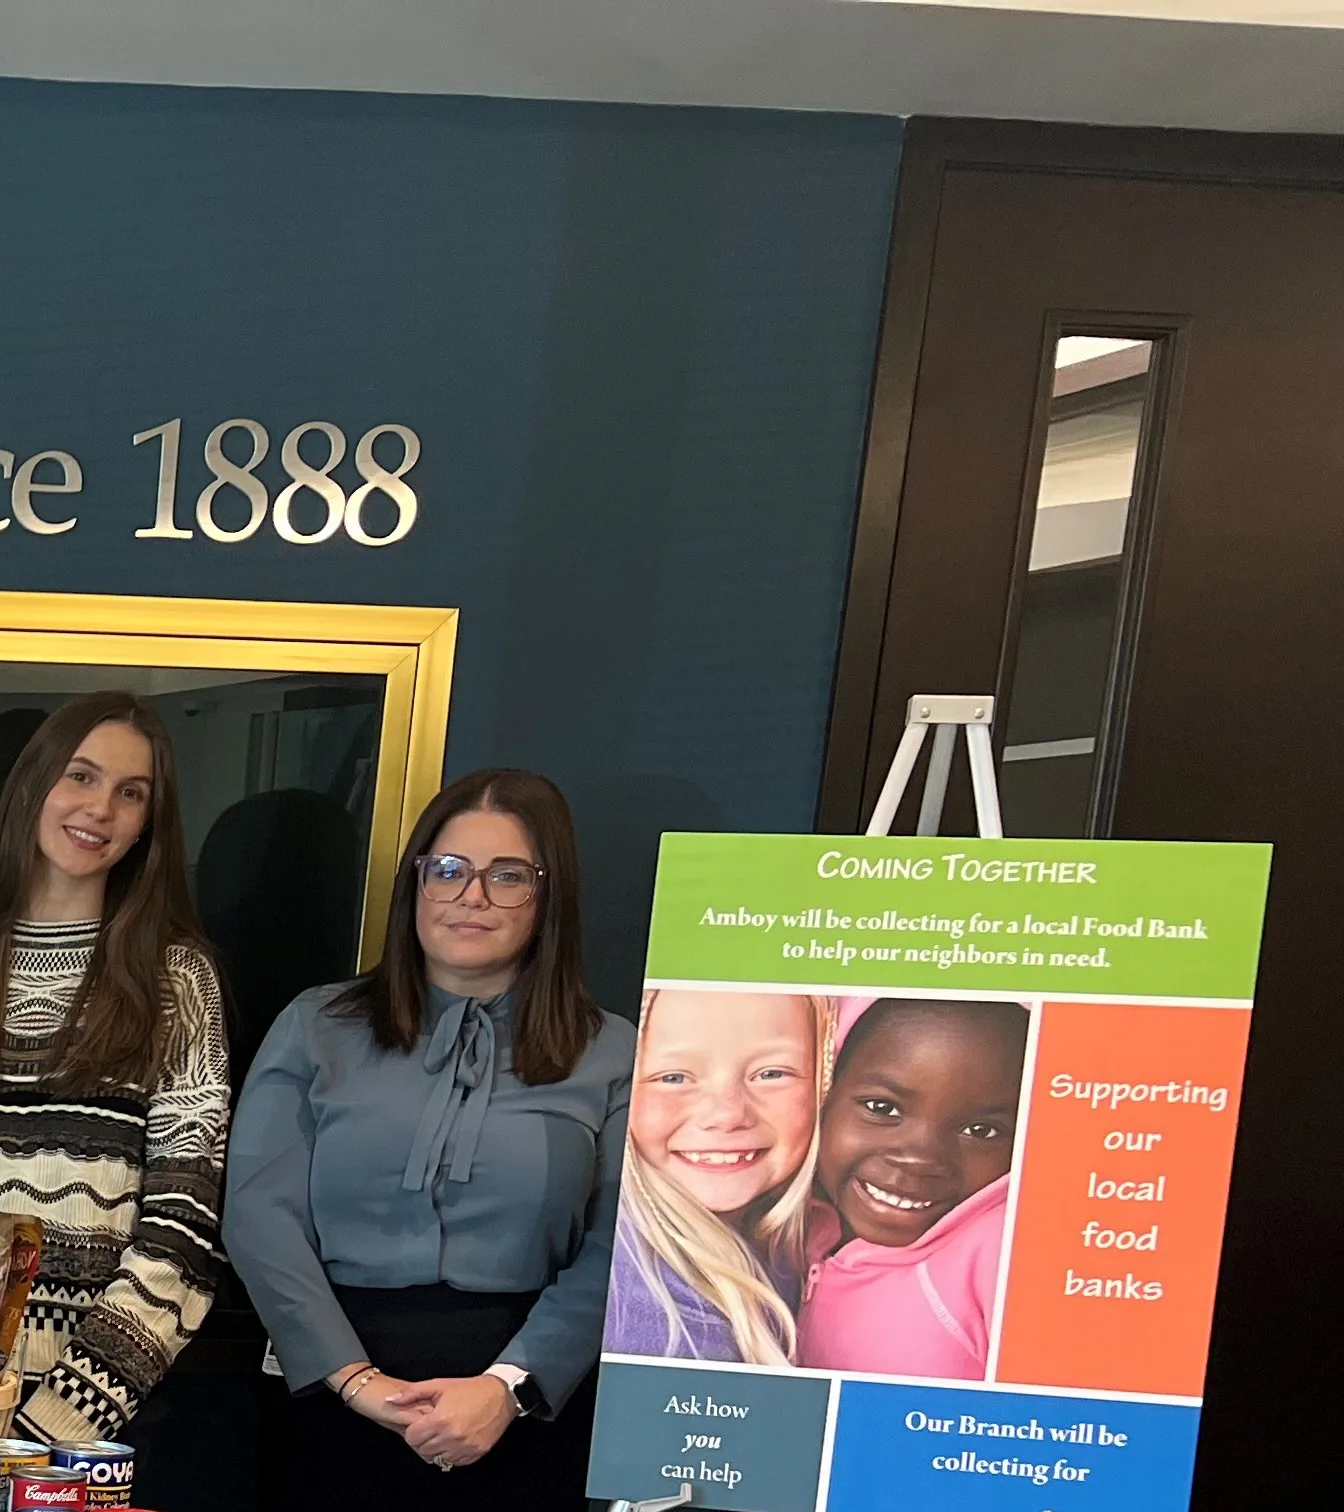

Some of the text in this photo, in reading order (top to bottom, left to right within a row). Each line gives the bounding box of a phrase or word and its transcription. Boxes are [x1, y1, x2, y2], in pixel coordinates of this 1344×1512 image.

[131, 416, 422, 548] 1888
[817, 850, 1098, 884] COMING TOGETHER
[698, 906, 1210, 940] Amboy will be collecting for a local Food Bank
[782, 939, 1112, 970] to help our neighbors in need.
[1049, 1072, 1230, 1112] Supporting
[1103, 1128, 1162, 1154] our
[1087, 1172, 1166, 1203] local
[1080, 1220, 1159, 1253] food
[1064, 1269, 1165, 1303] banks
[663, 1395, 750, 1420] Ask how
[681, 1432, 722, 1453] you
[904, 1411, 1128, 1448] Our Branch will be
[72, 1460, 134, 1484] GOYA
[661, 1460, 743, 1490] can help
[931, 1452, 1091, 1485] collecting for
[24, 1484, 80, 1505] Campbell's
